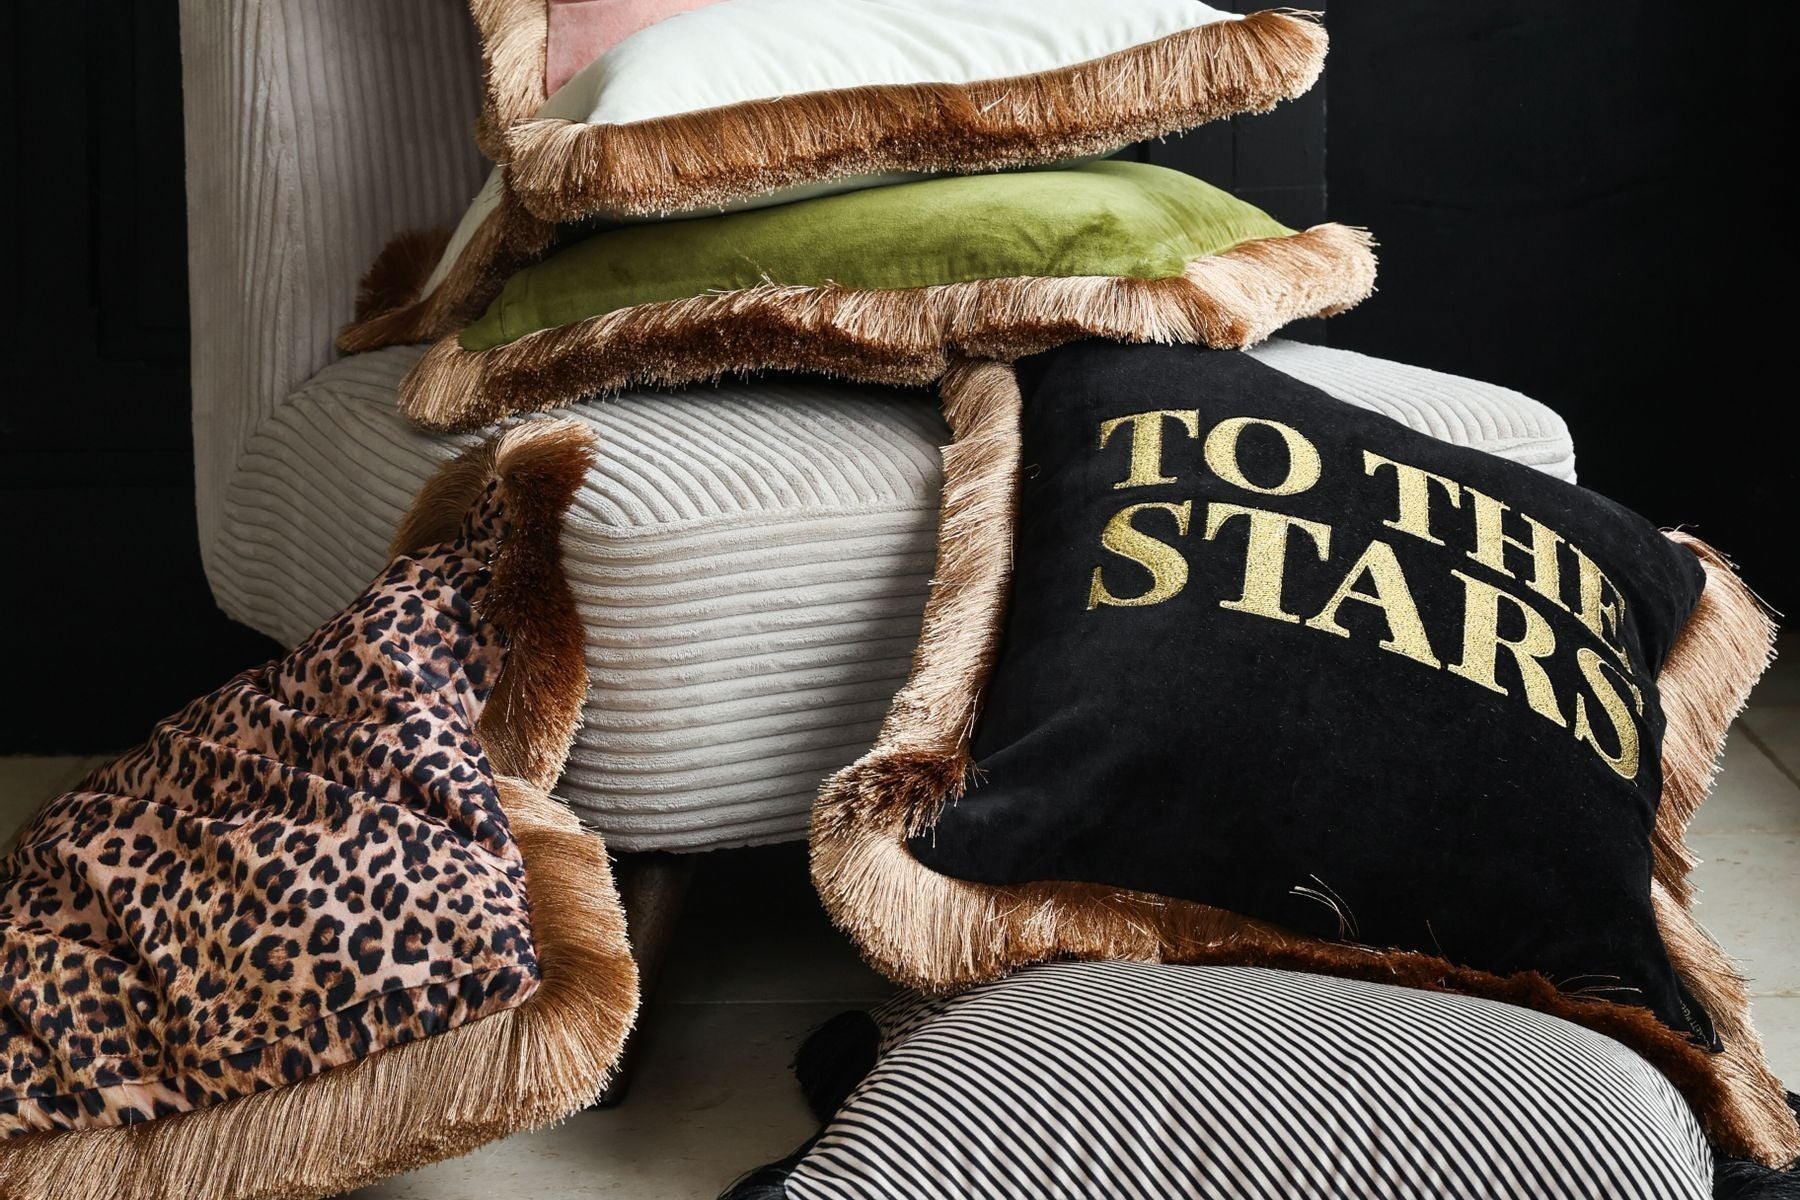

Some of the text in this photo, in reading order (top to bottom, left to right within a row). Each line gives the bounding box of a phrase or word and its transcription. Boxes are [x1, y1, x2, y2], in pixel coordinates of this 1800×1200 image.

[1086, 499, 1645, 780] STARS
[1099, 408, 1634, 676] TO THE
